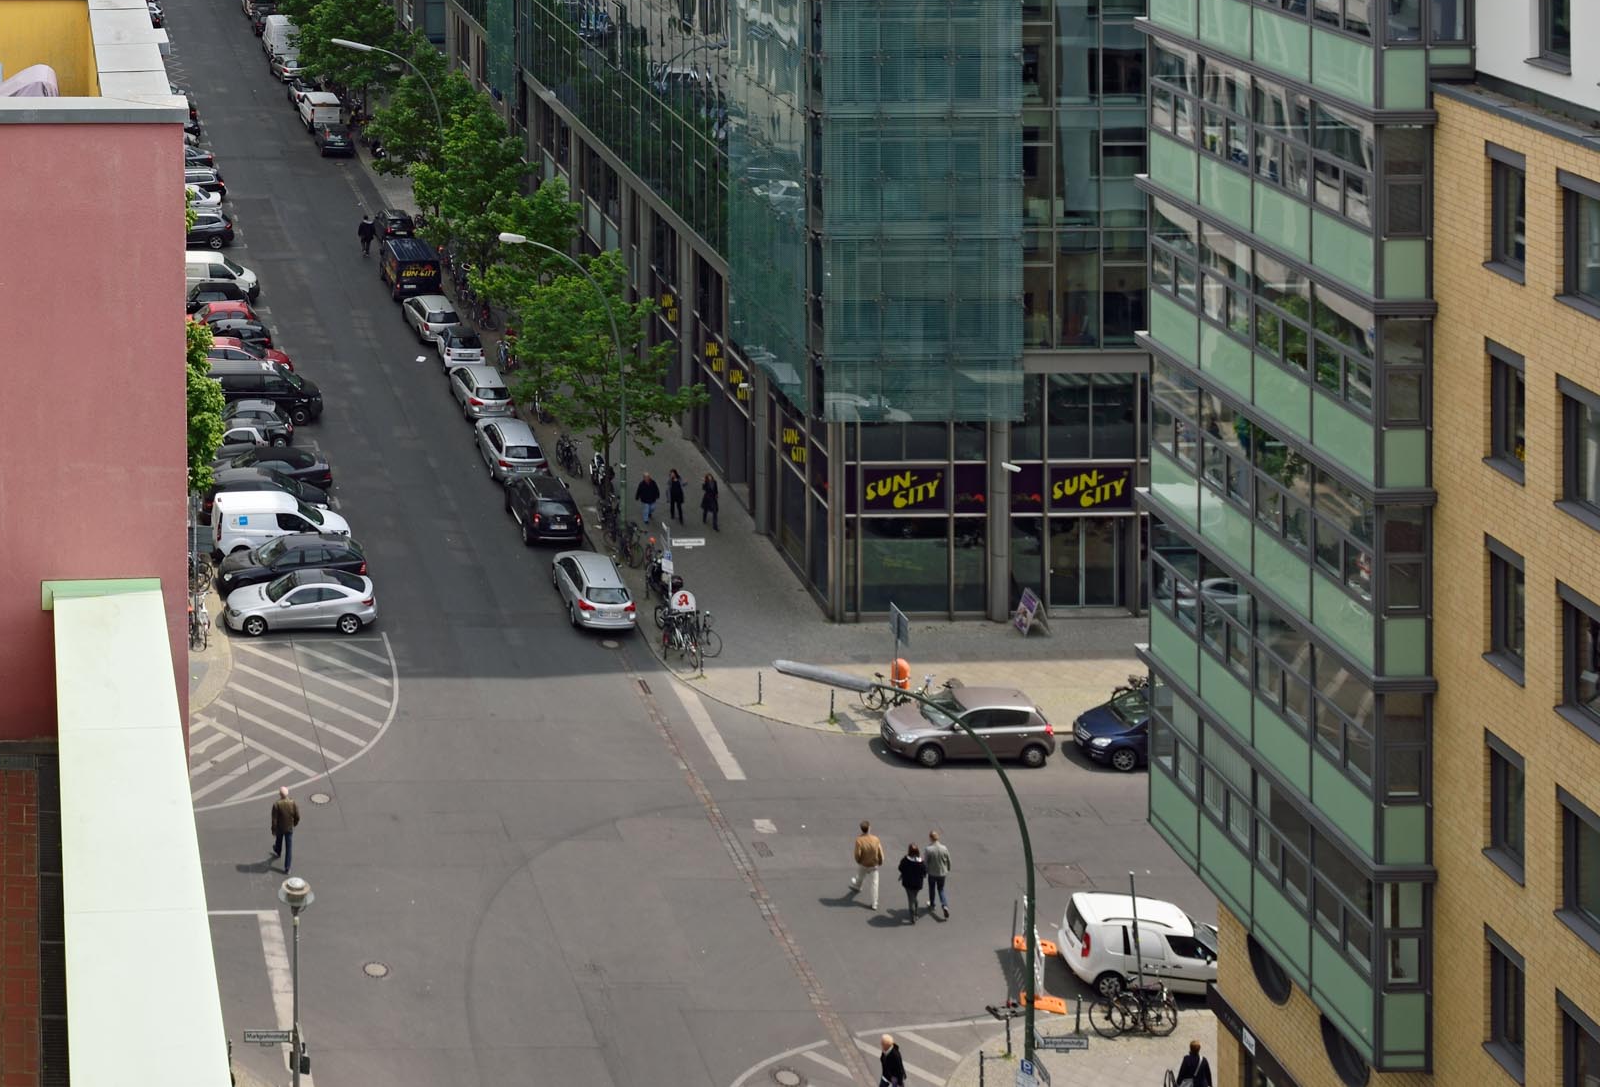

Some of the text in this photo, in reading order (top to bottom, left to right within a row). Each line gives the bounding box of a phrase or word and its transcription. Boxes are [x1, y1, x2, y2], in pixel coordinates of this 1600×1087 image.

[865, 470, 919, 501] SUN-
[893, 479, 940, 509] CITY
[1052, 469, 1105, 500] SUN-
[1080, 477, 1127, 508] CITY
